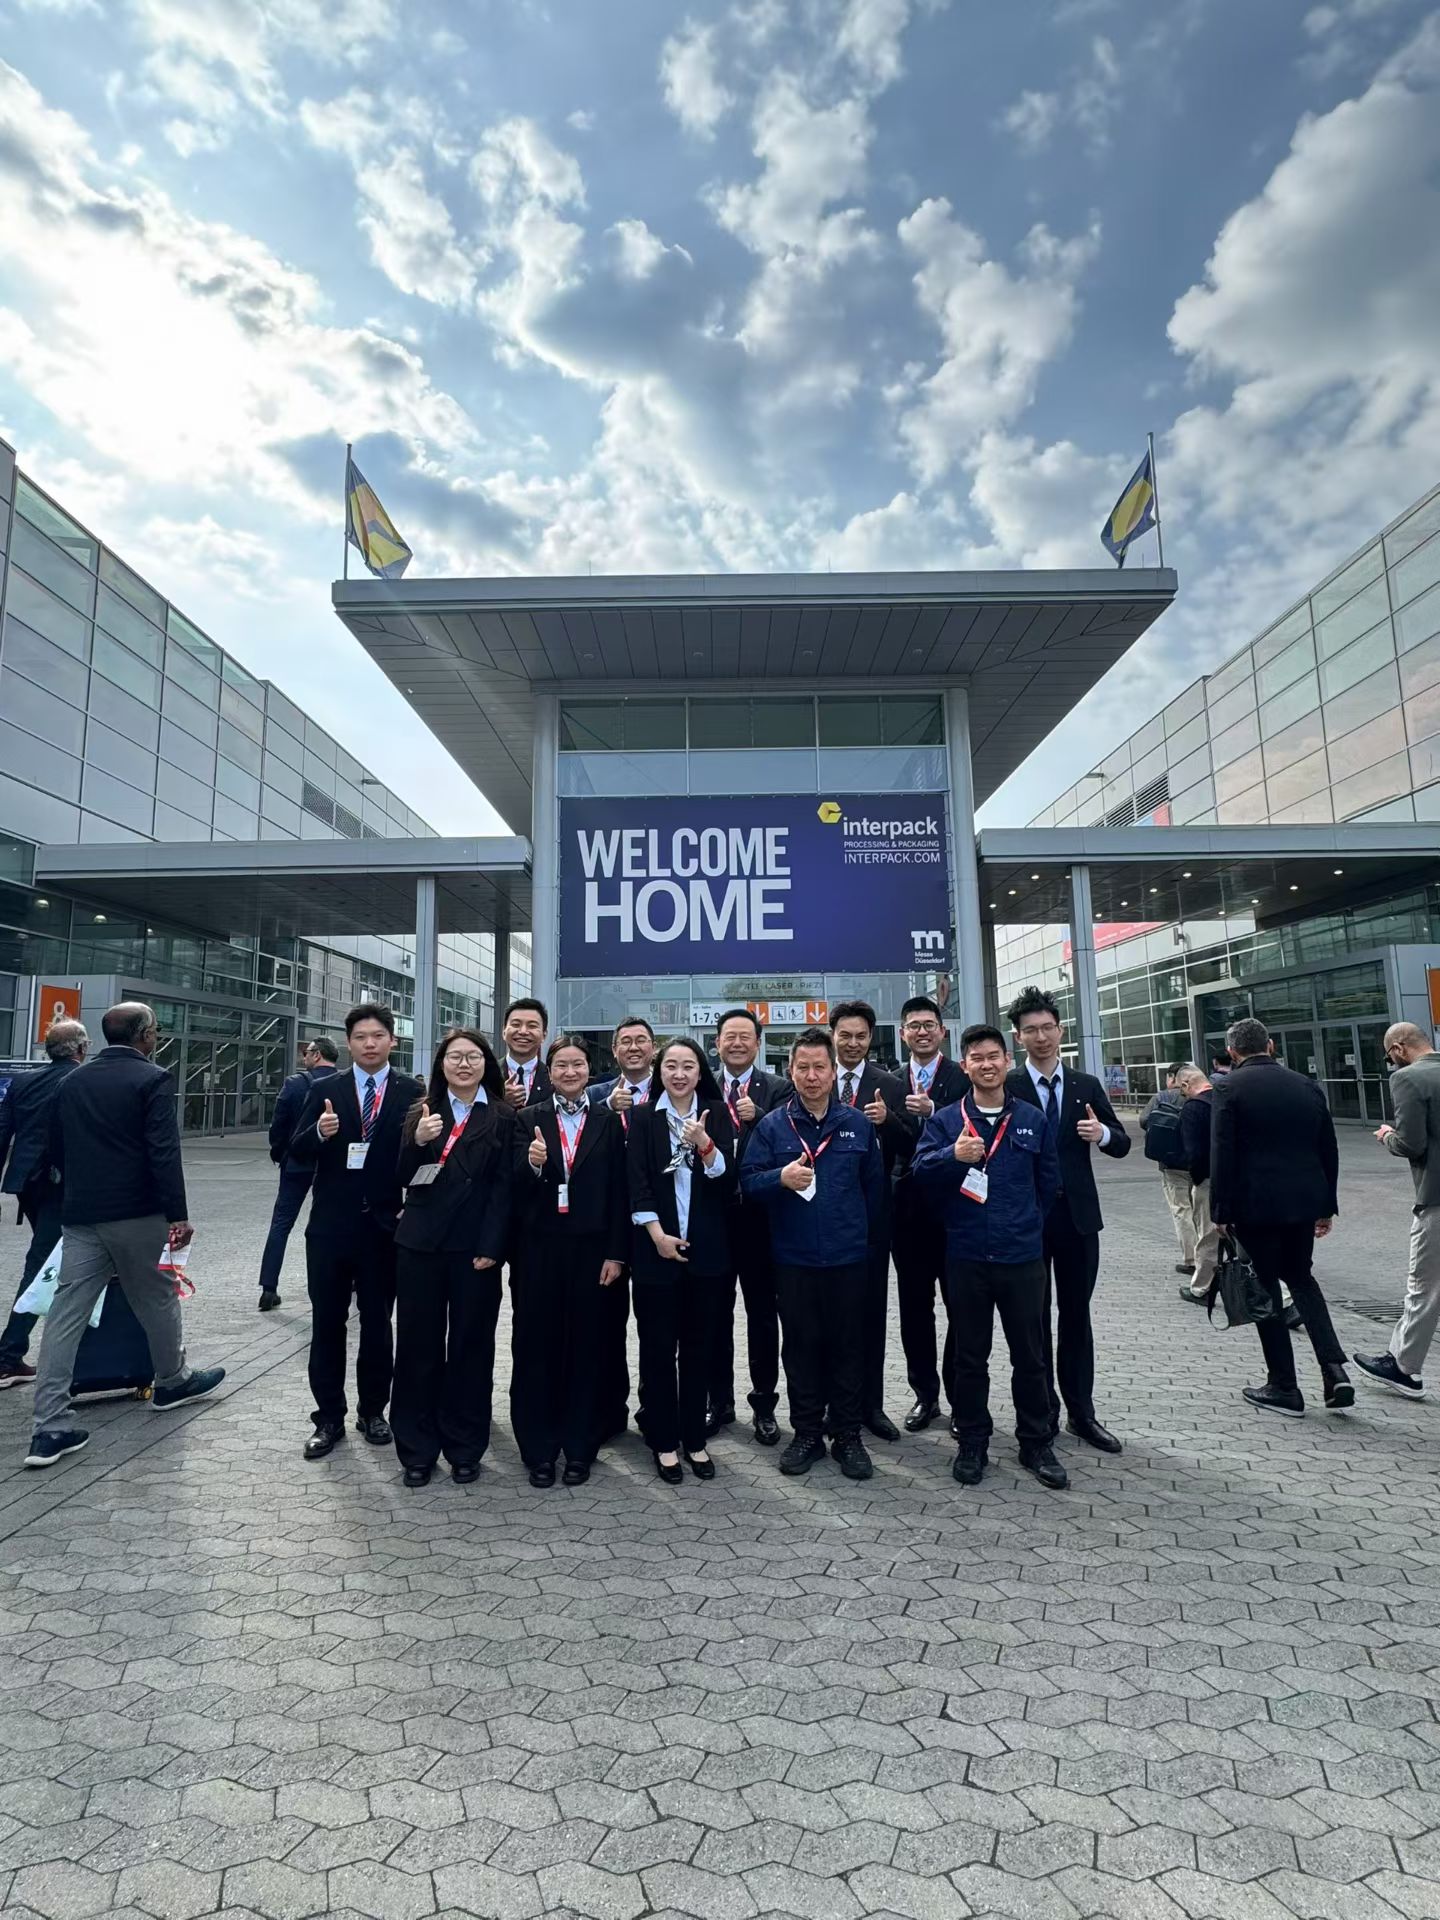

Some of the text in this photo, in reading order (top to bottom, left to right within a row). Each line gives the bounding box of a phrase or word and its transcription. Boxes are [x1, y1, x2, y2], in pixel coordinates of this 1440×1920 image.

[843, 816, 938, 840] interpack
[843, 841, 890, 849] PROCESSING
[898, 840, 940, 848] PACKAGING
[576, 827, 791, 878] WELCOME
[844, 852, 941, 864] INTERPACK.COM
[584, 879, 794, 943] HOME
[839, 1130, 856, 1138] UPG
[1016, 1127, 1034, 1136] UPG
